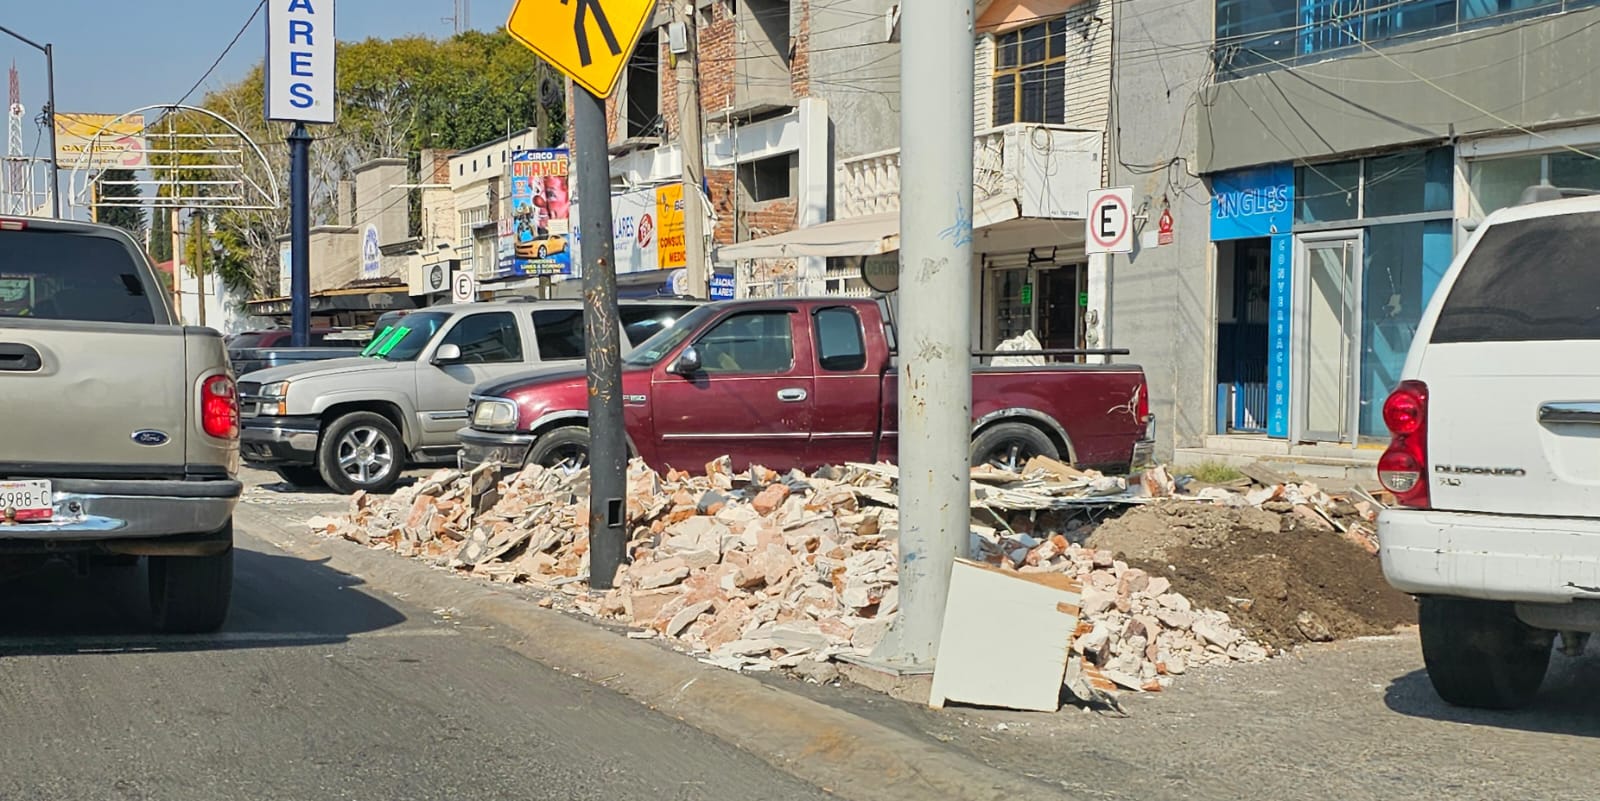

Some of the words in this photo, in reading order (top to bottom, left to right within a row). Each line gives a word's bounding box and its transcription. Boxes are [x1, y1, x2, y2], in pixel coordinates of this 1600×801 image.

[528, 152, 553, 160] CIRCO
[1217, 185, 1288, 219] INGLES
[1101, 204, 1117, 237] E
[460, 279, 468, 294] E
[1275, 239, 1286, 433] CONVERSACIONAL
[140, 434, 160, 442] Ford
[1434, 464, 1526, 477] DURANGO
